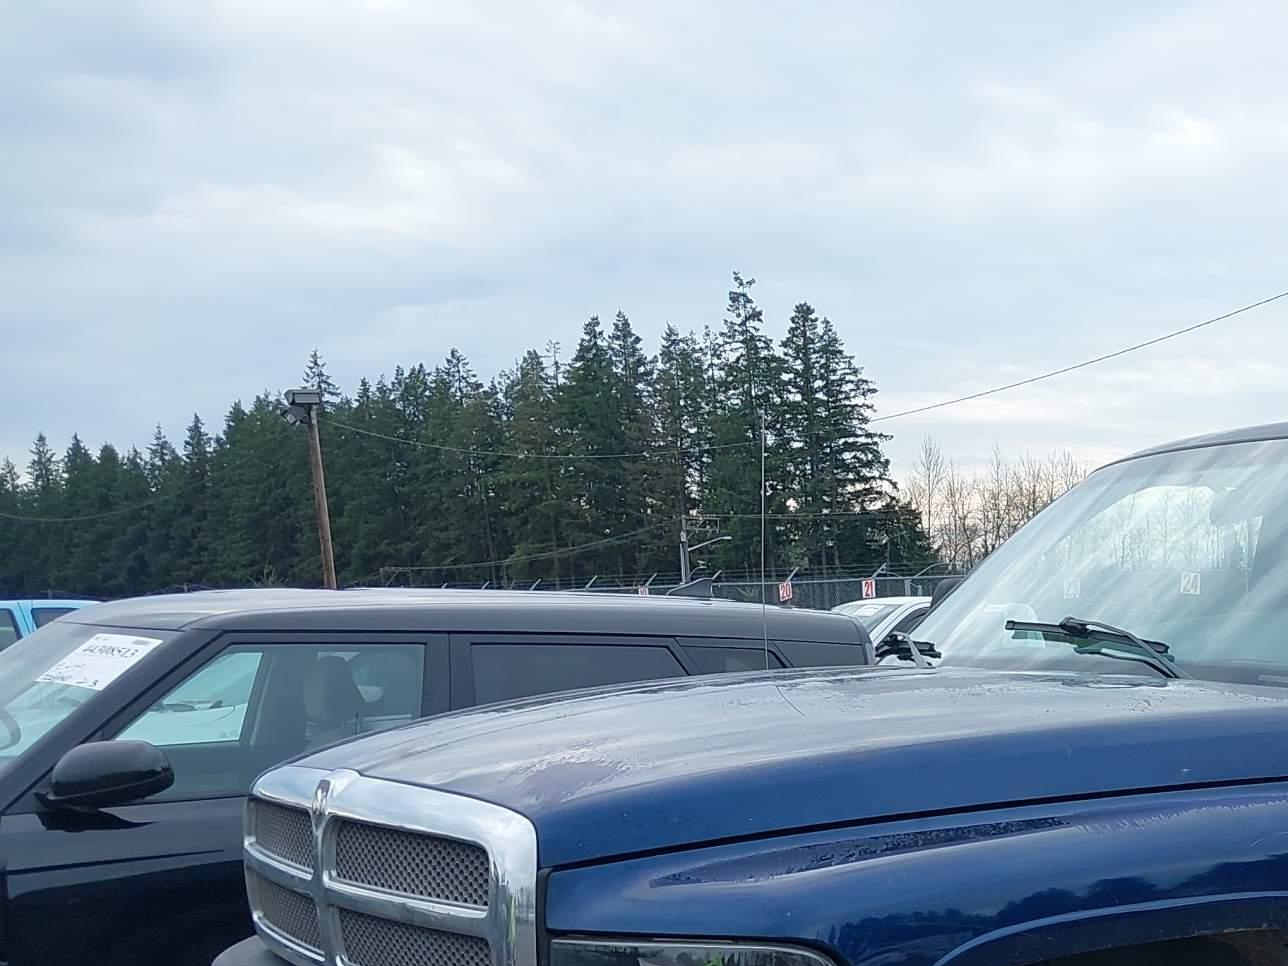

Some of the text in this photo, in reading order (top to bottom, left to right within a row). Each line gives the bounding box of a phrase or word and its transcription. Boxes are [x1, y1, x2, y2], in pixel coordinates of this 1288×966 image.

[781, 583, 791, 599] 20
[864, 581, 874, 597] 21
[1183, 574, 1198, 593] 24
